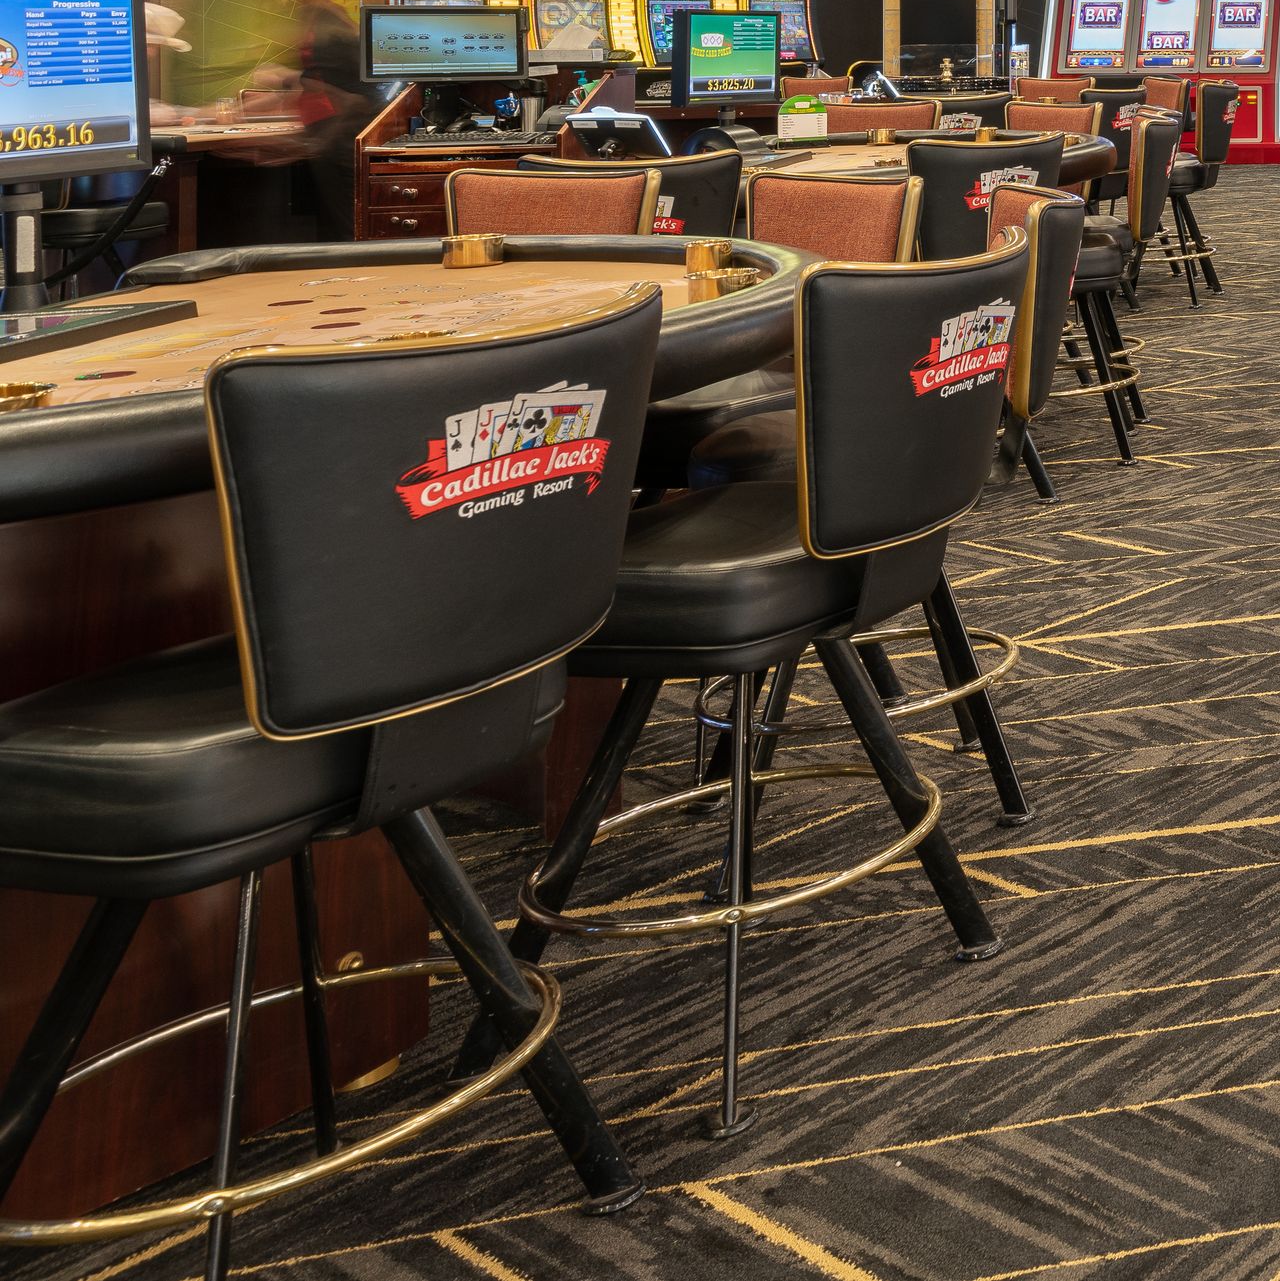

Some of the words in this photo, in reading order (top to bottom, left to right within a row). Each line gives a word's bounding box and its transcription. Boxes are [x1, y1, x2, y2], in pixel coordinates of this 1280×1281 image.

[1085, 8, 1117, 22] BAR
[1225, 8, 1256, 22] BAR
[692, 47, 705, 57] THREE
[706, 48, 718, 57] CARD
[718, 47, 732, 57] POKER
[1153, 37, 1183, 49] BAR
[708, 78, 755, 91] $3,825.20
[0, 121, 94, 152] ,963.16
[922, 350, 982, 388] Cadillac
[984, 347, 1008, 368] Jack's
[940, 378, 973, 398] Gaming
[976, 371, 996, 386] Resort
[420, 456, 541, 507] Cadillac
[544, 444, 601, 476] Jack's
[458, 490, 525, 519] Gaming
[533, 476, 574, 499] Resort
